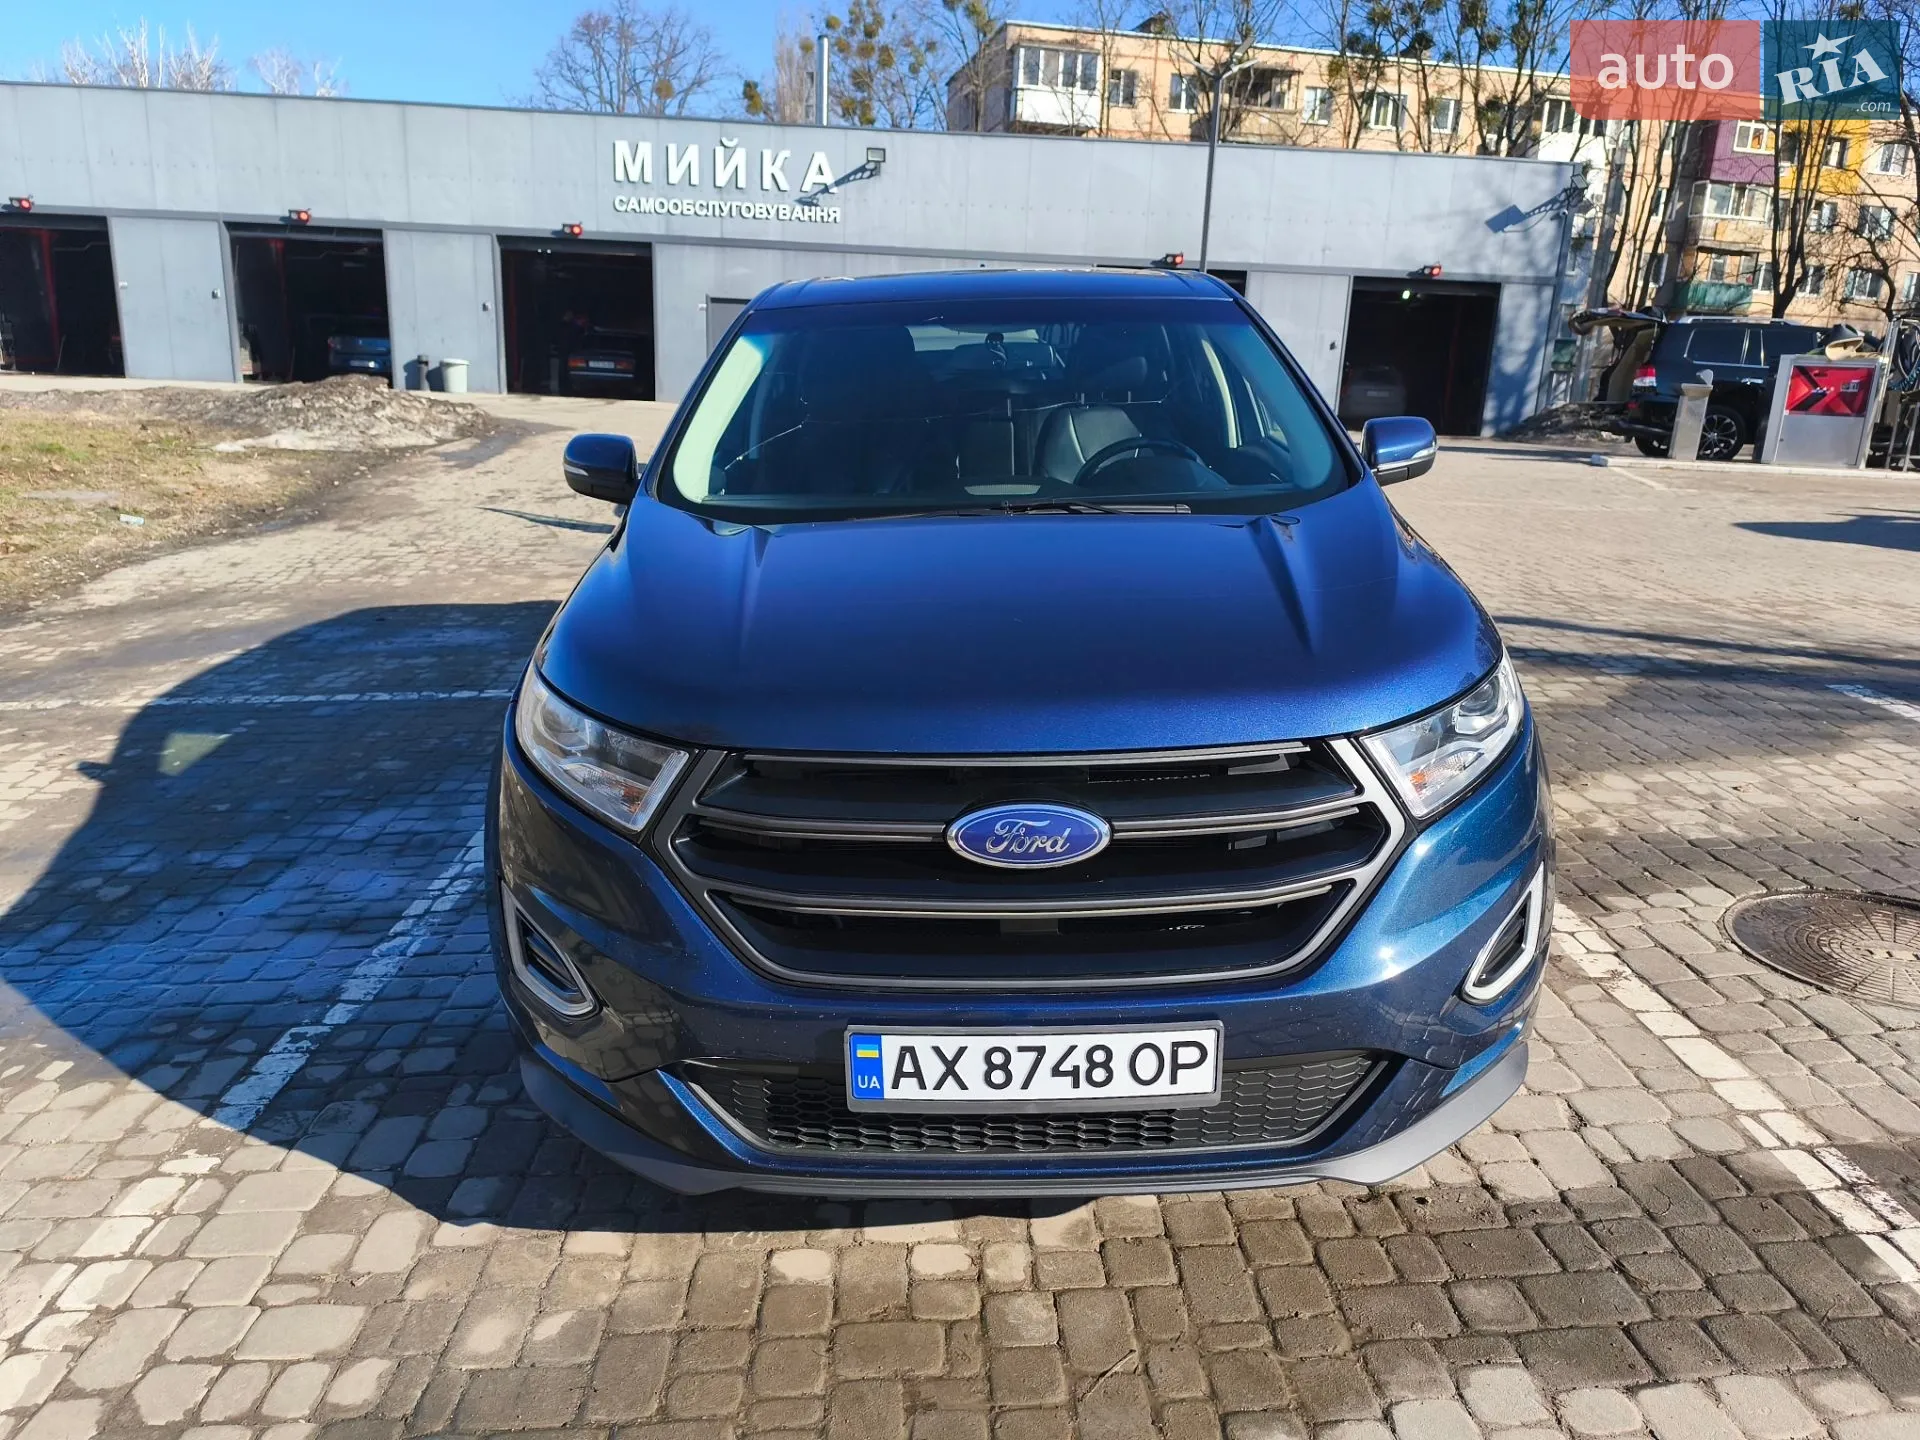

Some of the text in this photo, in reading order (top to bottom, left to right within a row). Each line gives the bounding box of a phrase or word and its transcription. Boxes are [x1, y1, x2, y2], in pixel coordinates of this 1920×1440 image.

[613, 137, 838, 193] МИЙКА
[613, 196, 841, 223] САМООБСЛУГОВУВАННЯ
[986, 818, 1071, 854] Ford
[858, 1075, 881, 1089] UA
[891, 1040, 1208, 1090] AX 8748 OP
